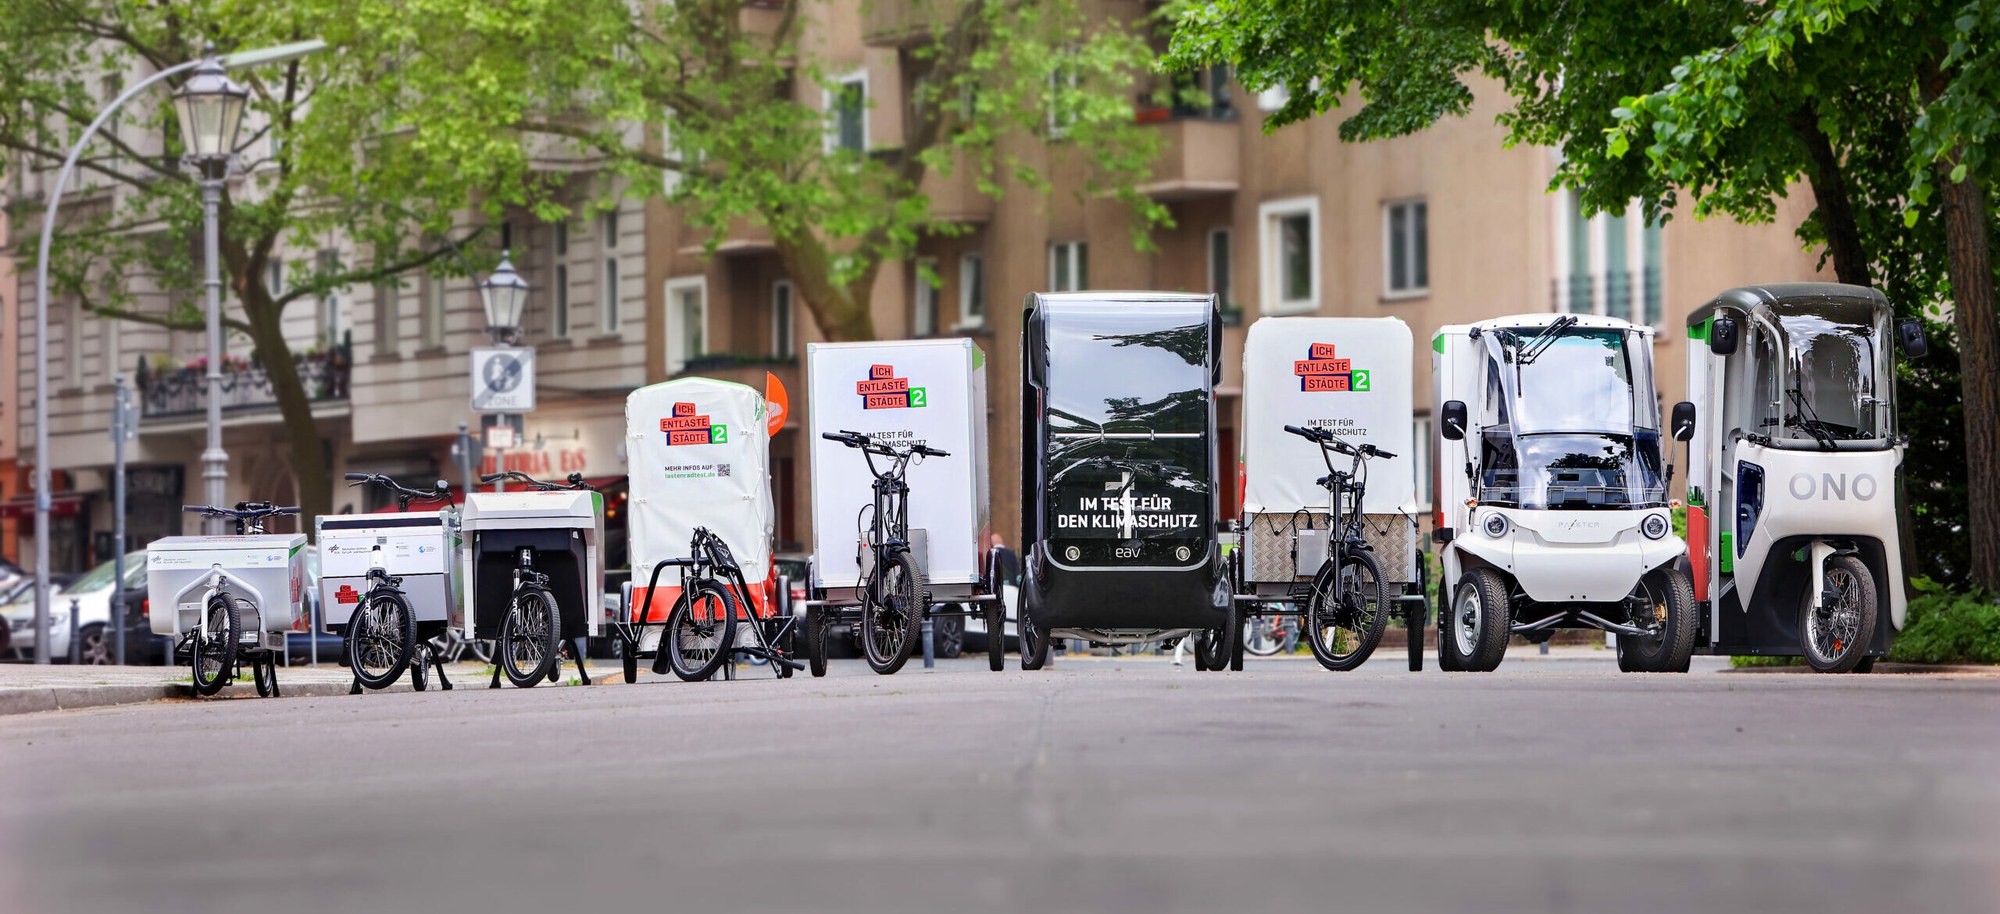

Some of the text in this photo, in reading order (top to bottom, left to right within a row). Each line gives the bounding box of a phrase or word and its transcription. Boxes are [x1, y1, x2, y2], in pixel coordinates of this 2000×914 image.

[1315, 347, 1332, 356] ICH
[875, 368, 891, 376] ICH
[1297, 362, 1348, 372] ENTLASTE
[1308, 372, 1368, 389] STÄDTE 2
[859, 381, 905, 392] ENTLASTE
[488, 396, 517, 406] ZONE
[870, 390, 924, 406] STÄDTE 2
[678, 405, 693, 413] ICH
[662, 418, 708, 429] ENTLASTE
[1338, 418, 1354, 426] FÜR
[673, 427, 726, 443] STÄDTE 2
[897, 430, 913, 438] FÜR
[665, 471, 715, 479] lastenradtest.de
[1789, 473, 1877, 501] ONO
[1080, 494, 1172, 511] IM TEST FÜR
[1058, 515, 1198, 528] DEN KLIMASCHUTZ
[1558, 520, 1600, 530] PAXSTER
[1115, 547, 1141, 558] eav
